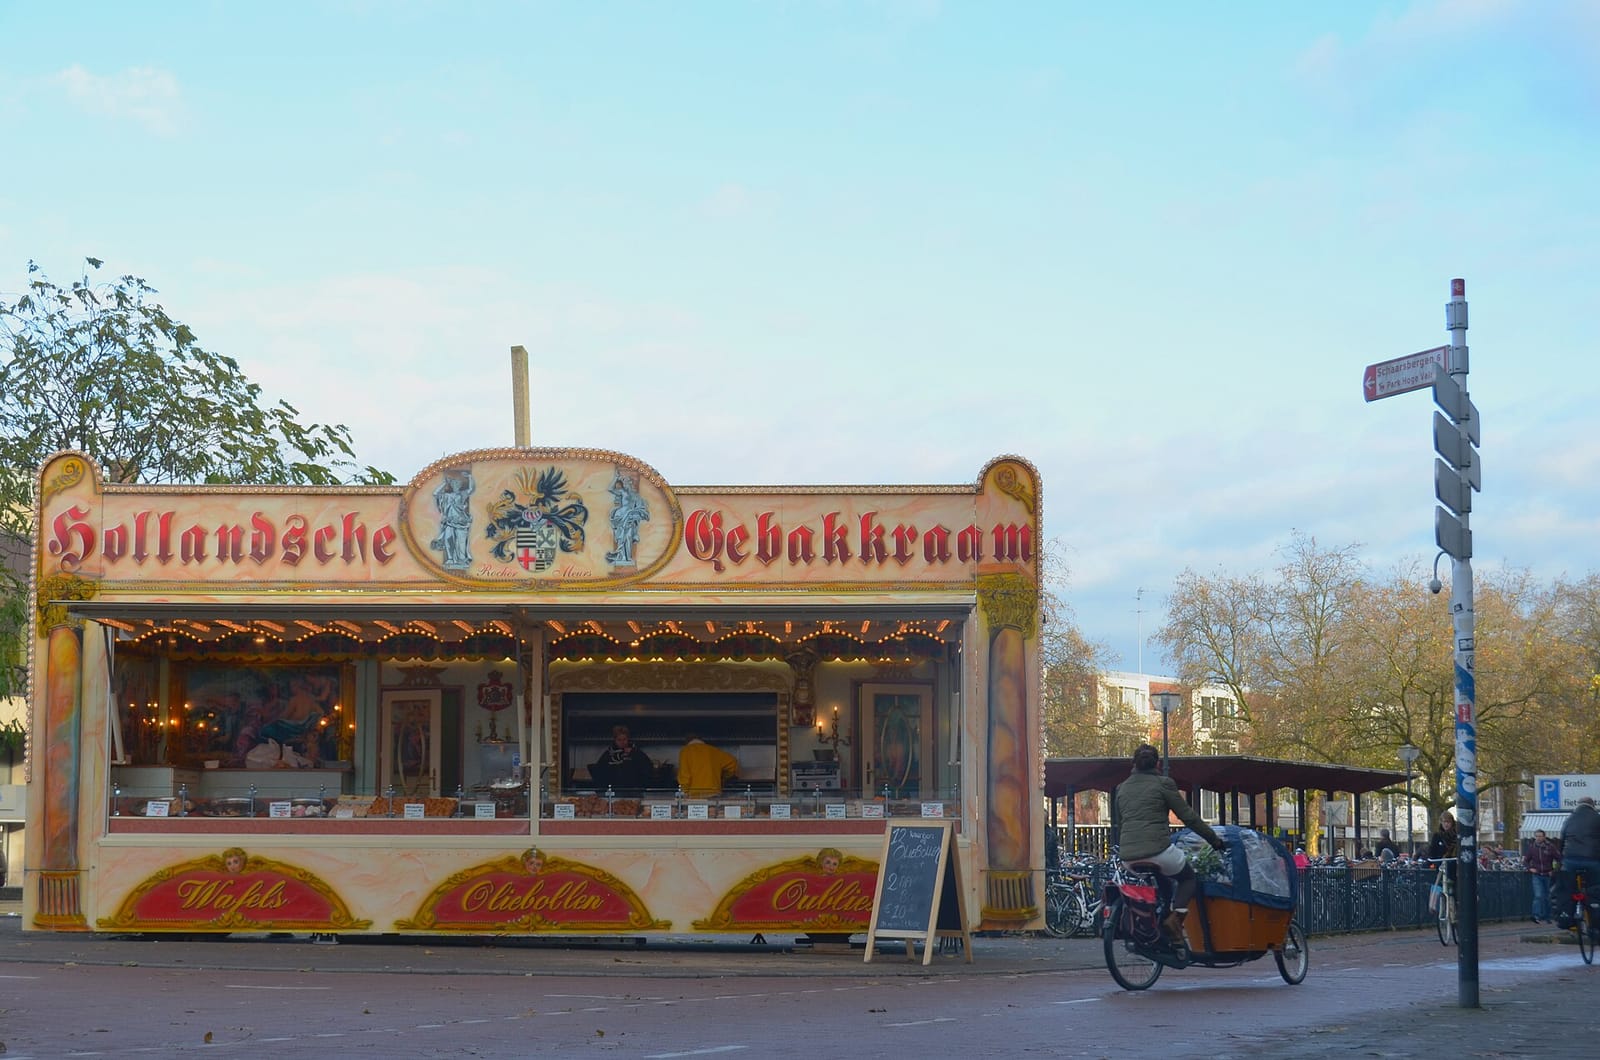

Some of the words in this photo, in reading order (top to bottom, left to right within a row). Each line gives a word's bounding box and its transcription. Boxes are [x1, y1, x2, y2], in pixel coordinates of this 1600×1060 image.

[1377, 356, 1434, 377] Schaarsbergen
[48, 505, 397, 572] Hollandsche
[684, 508, 1035, 572] Gebakkraam
[1543, 781, 1555, 797] P
[1563, 779, 1587, 788] Gratis
[177, 880, 289, 913] Wafels
[462, 880, 604, 912] Oliebollen
